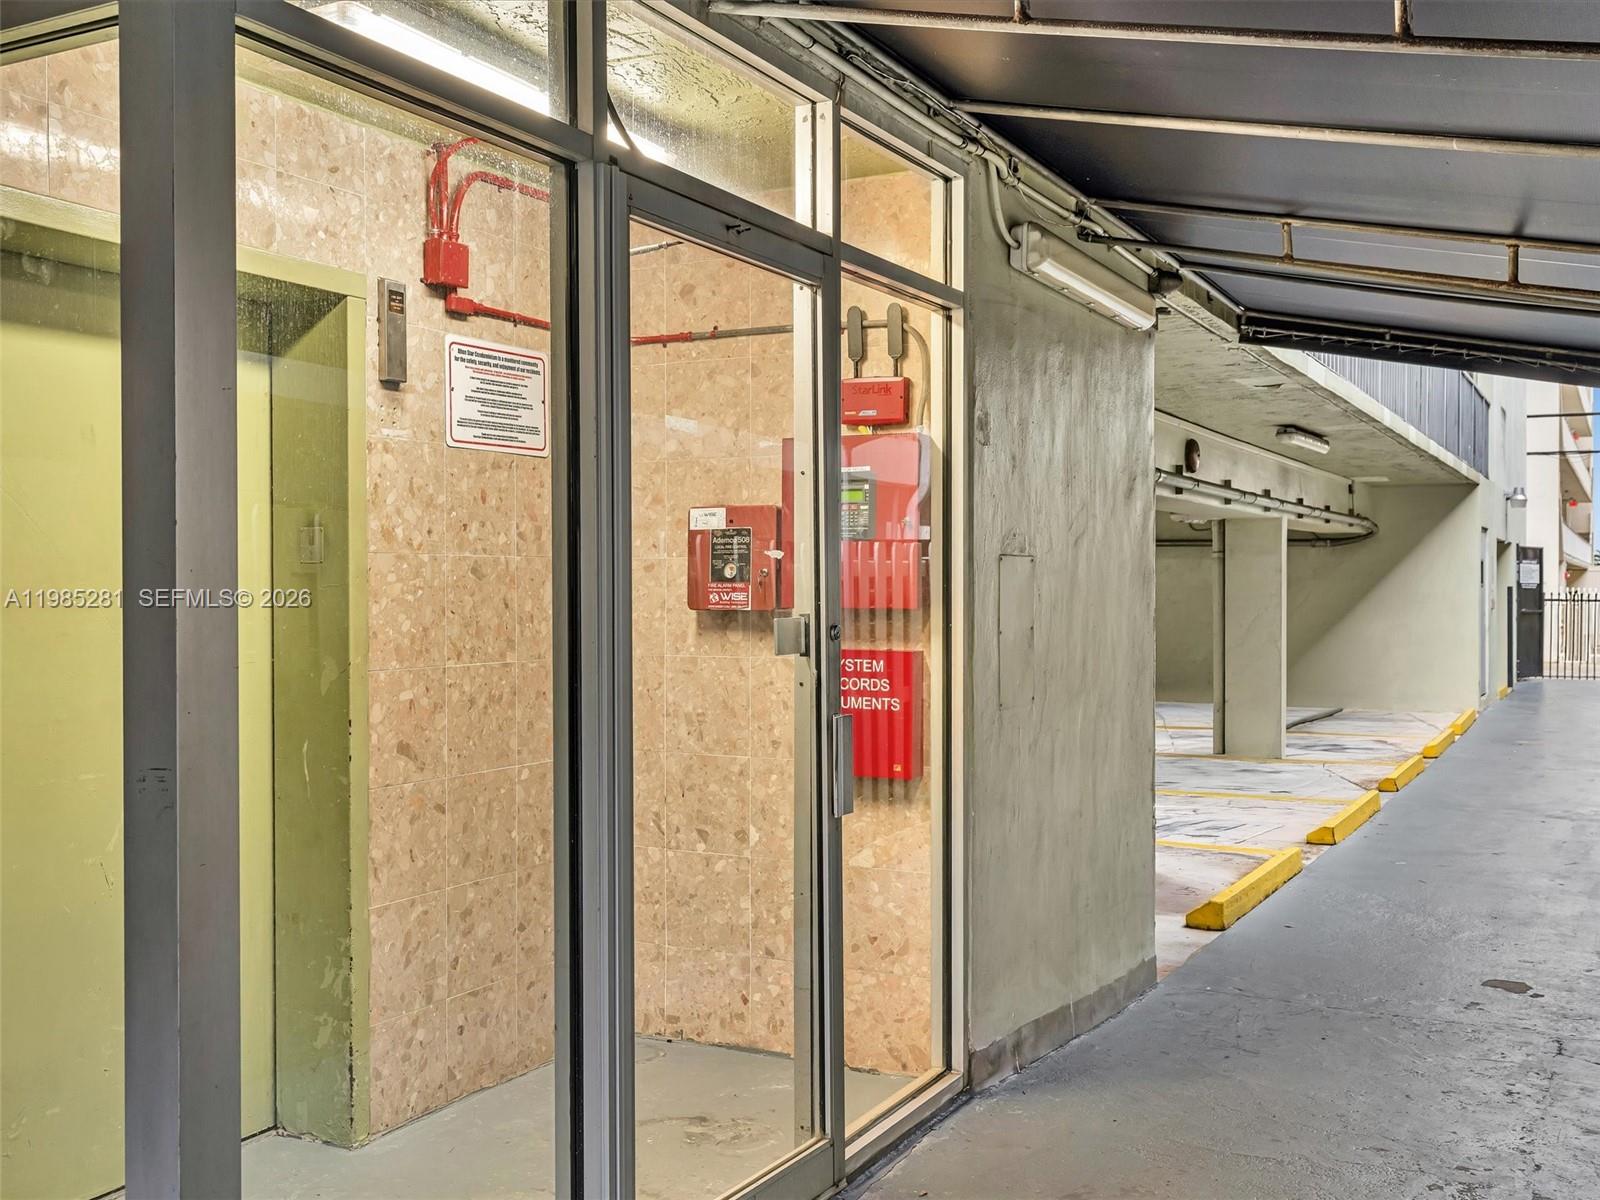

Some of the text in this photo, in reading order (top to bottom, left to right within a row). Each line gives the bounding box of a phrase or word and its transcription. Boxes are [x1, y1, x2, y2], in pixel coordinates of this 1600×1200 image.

[851, 384, 892, 395] StarLink
[720, 592, 748, 600] WISE
[841, 678, 890, 692] CORDS
[841, 697, 901, 711] UMENTS
